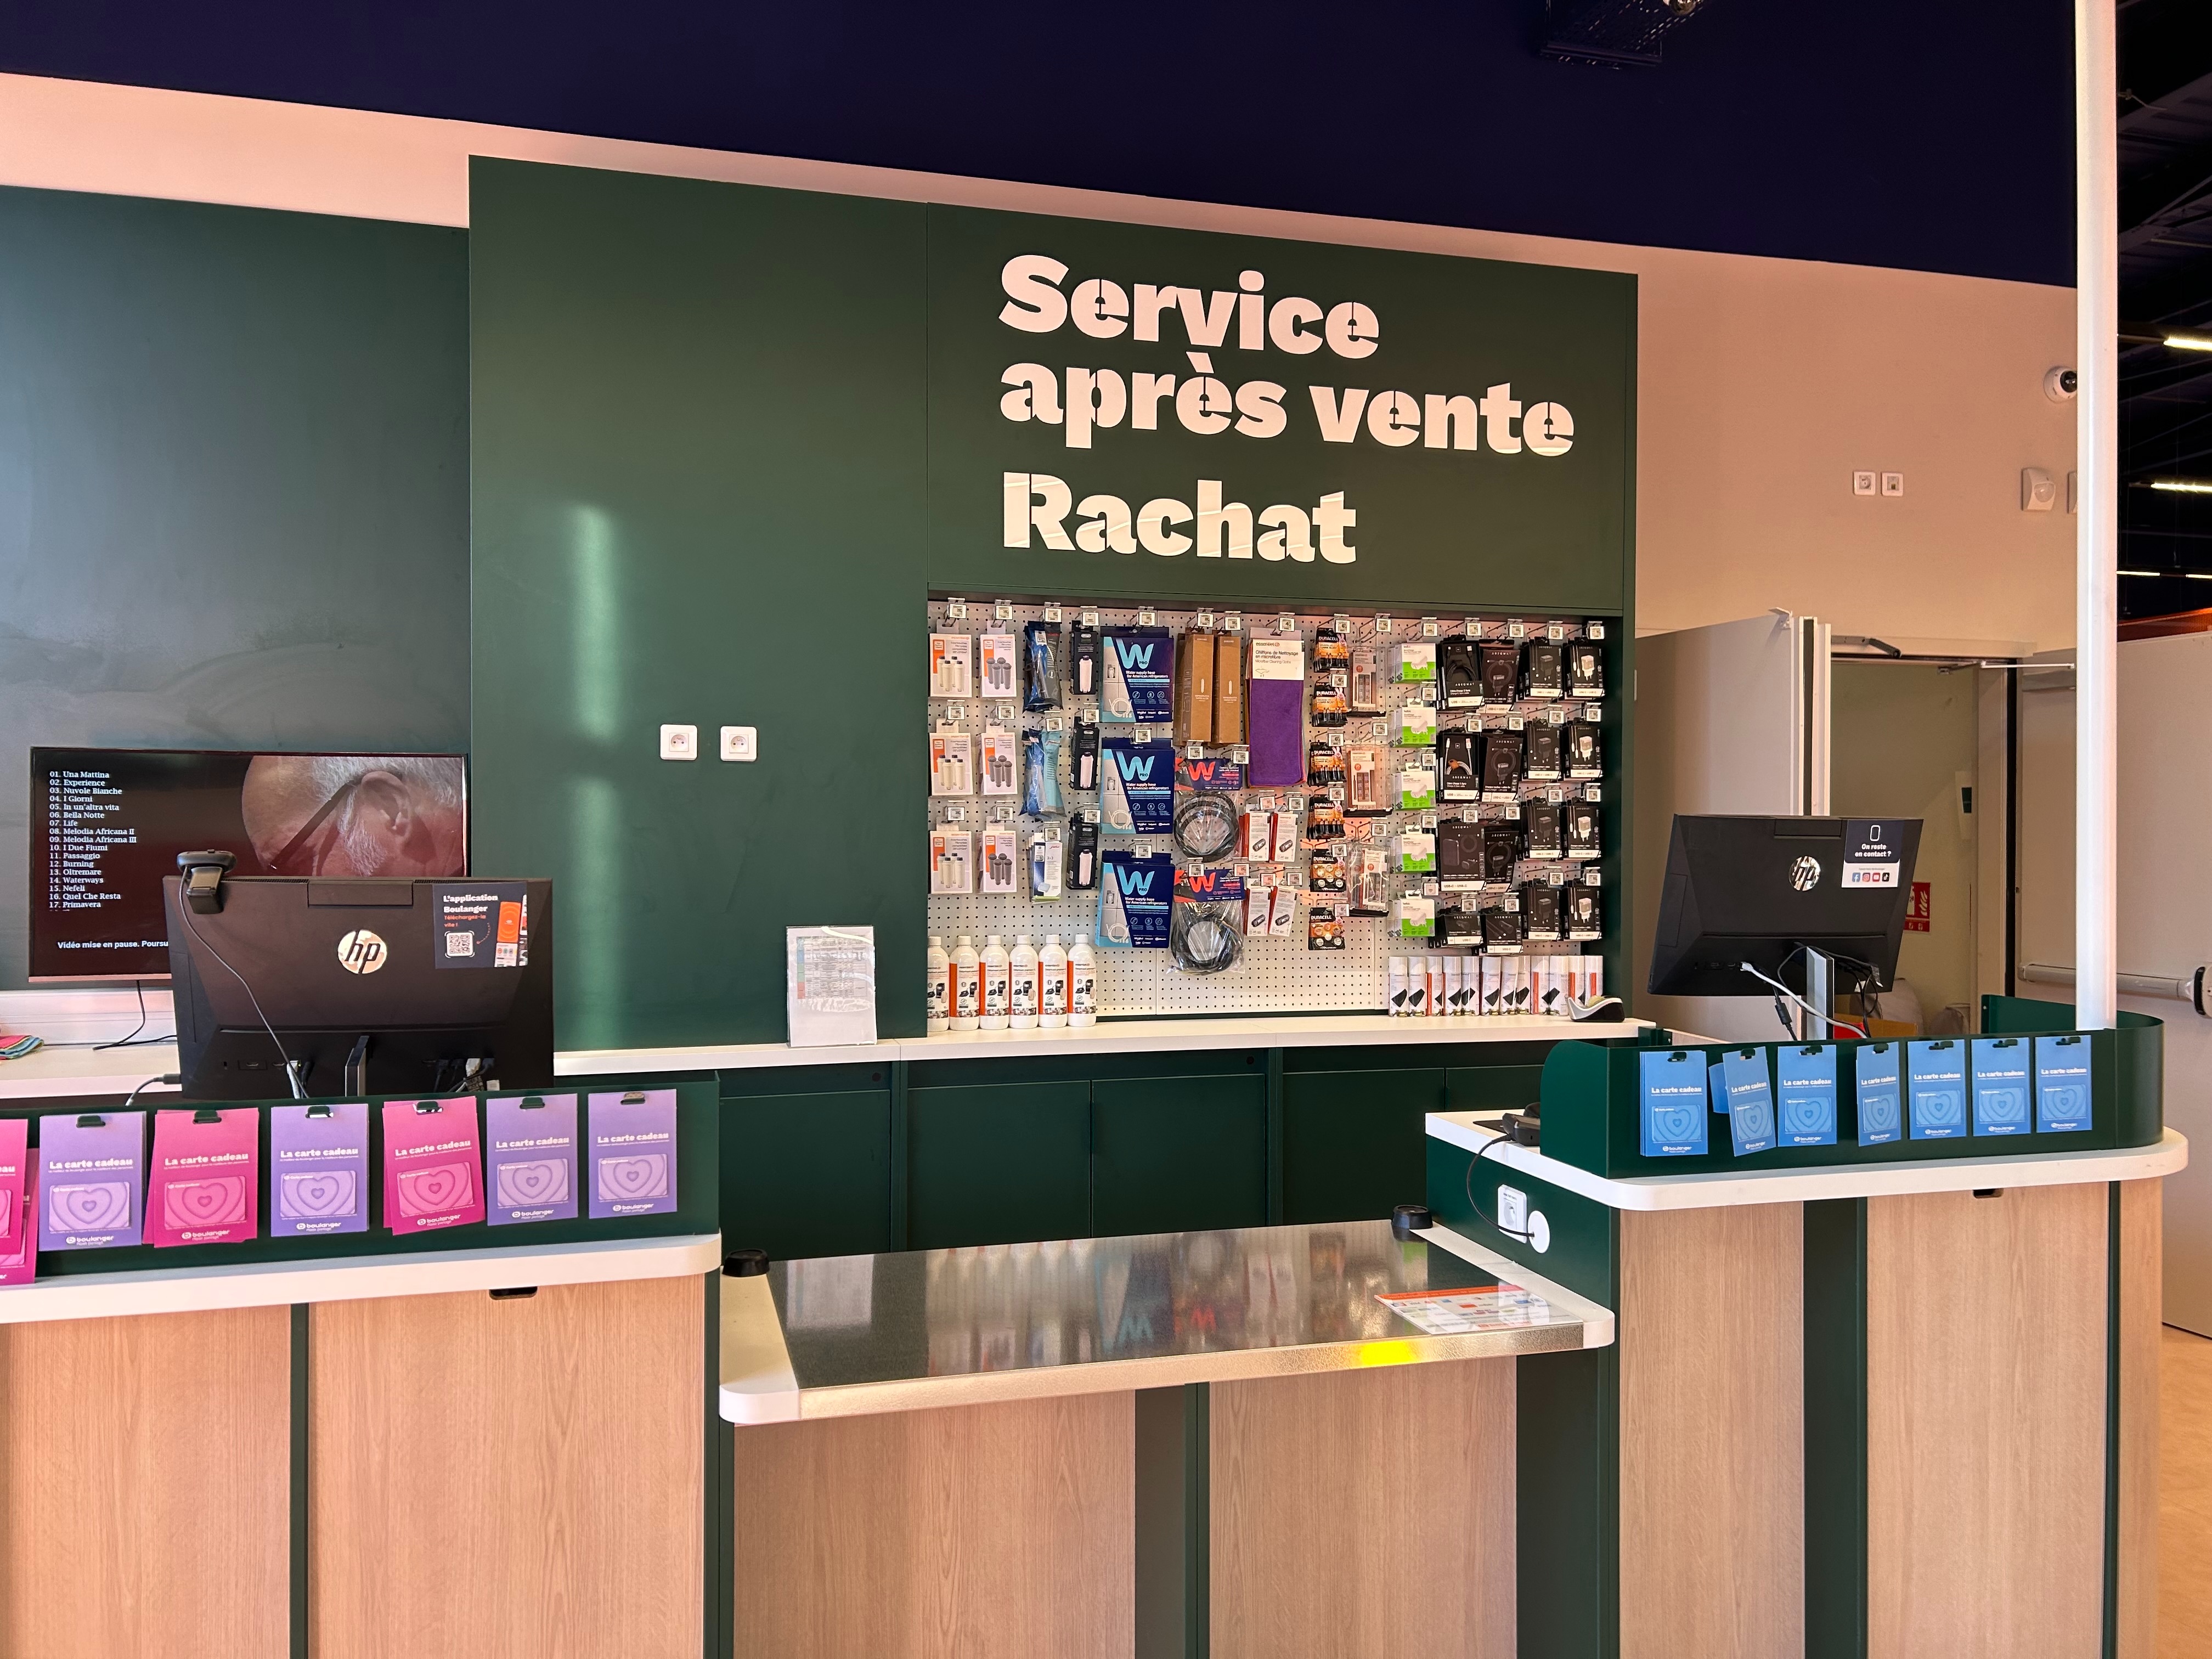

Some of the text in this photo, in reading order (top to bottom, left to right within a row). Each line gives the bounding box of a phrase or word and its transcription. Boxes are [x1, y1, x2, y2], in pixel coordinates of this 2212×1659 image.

[998, 254, 1379, 359] Service
[1000, 352, 1574, 456] après vente
[1003, 471, 1356, 564] Rachat
[1115, 639, 1154, 669] W
[1116, 751, 1155, 781] W
[1116, 865, 1155, 895] W
[443, 894, 498, 903] L'application
[443, 905, 488, 914] Boulanger
[340, 930, 384, 974] hp
[409, 1145, 435, 1154] carte
[437, 1141, 471, 1150] cadeau
[536, 1137, 569, 1145] cadeau
[180, 1156, 208, 1164] carte
[211, 1153, 249, 1161] cadeau
[323, 1148, 358, 1156] cadeau
[49, 1158, 133, 1169] La carte cadeau
[427, 1214, 461, 1223] boulanger
